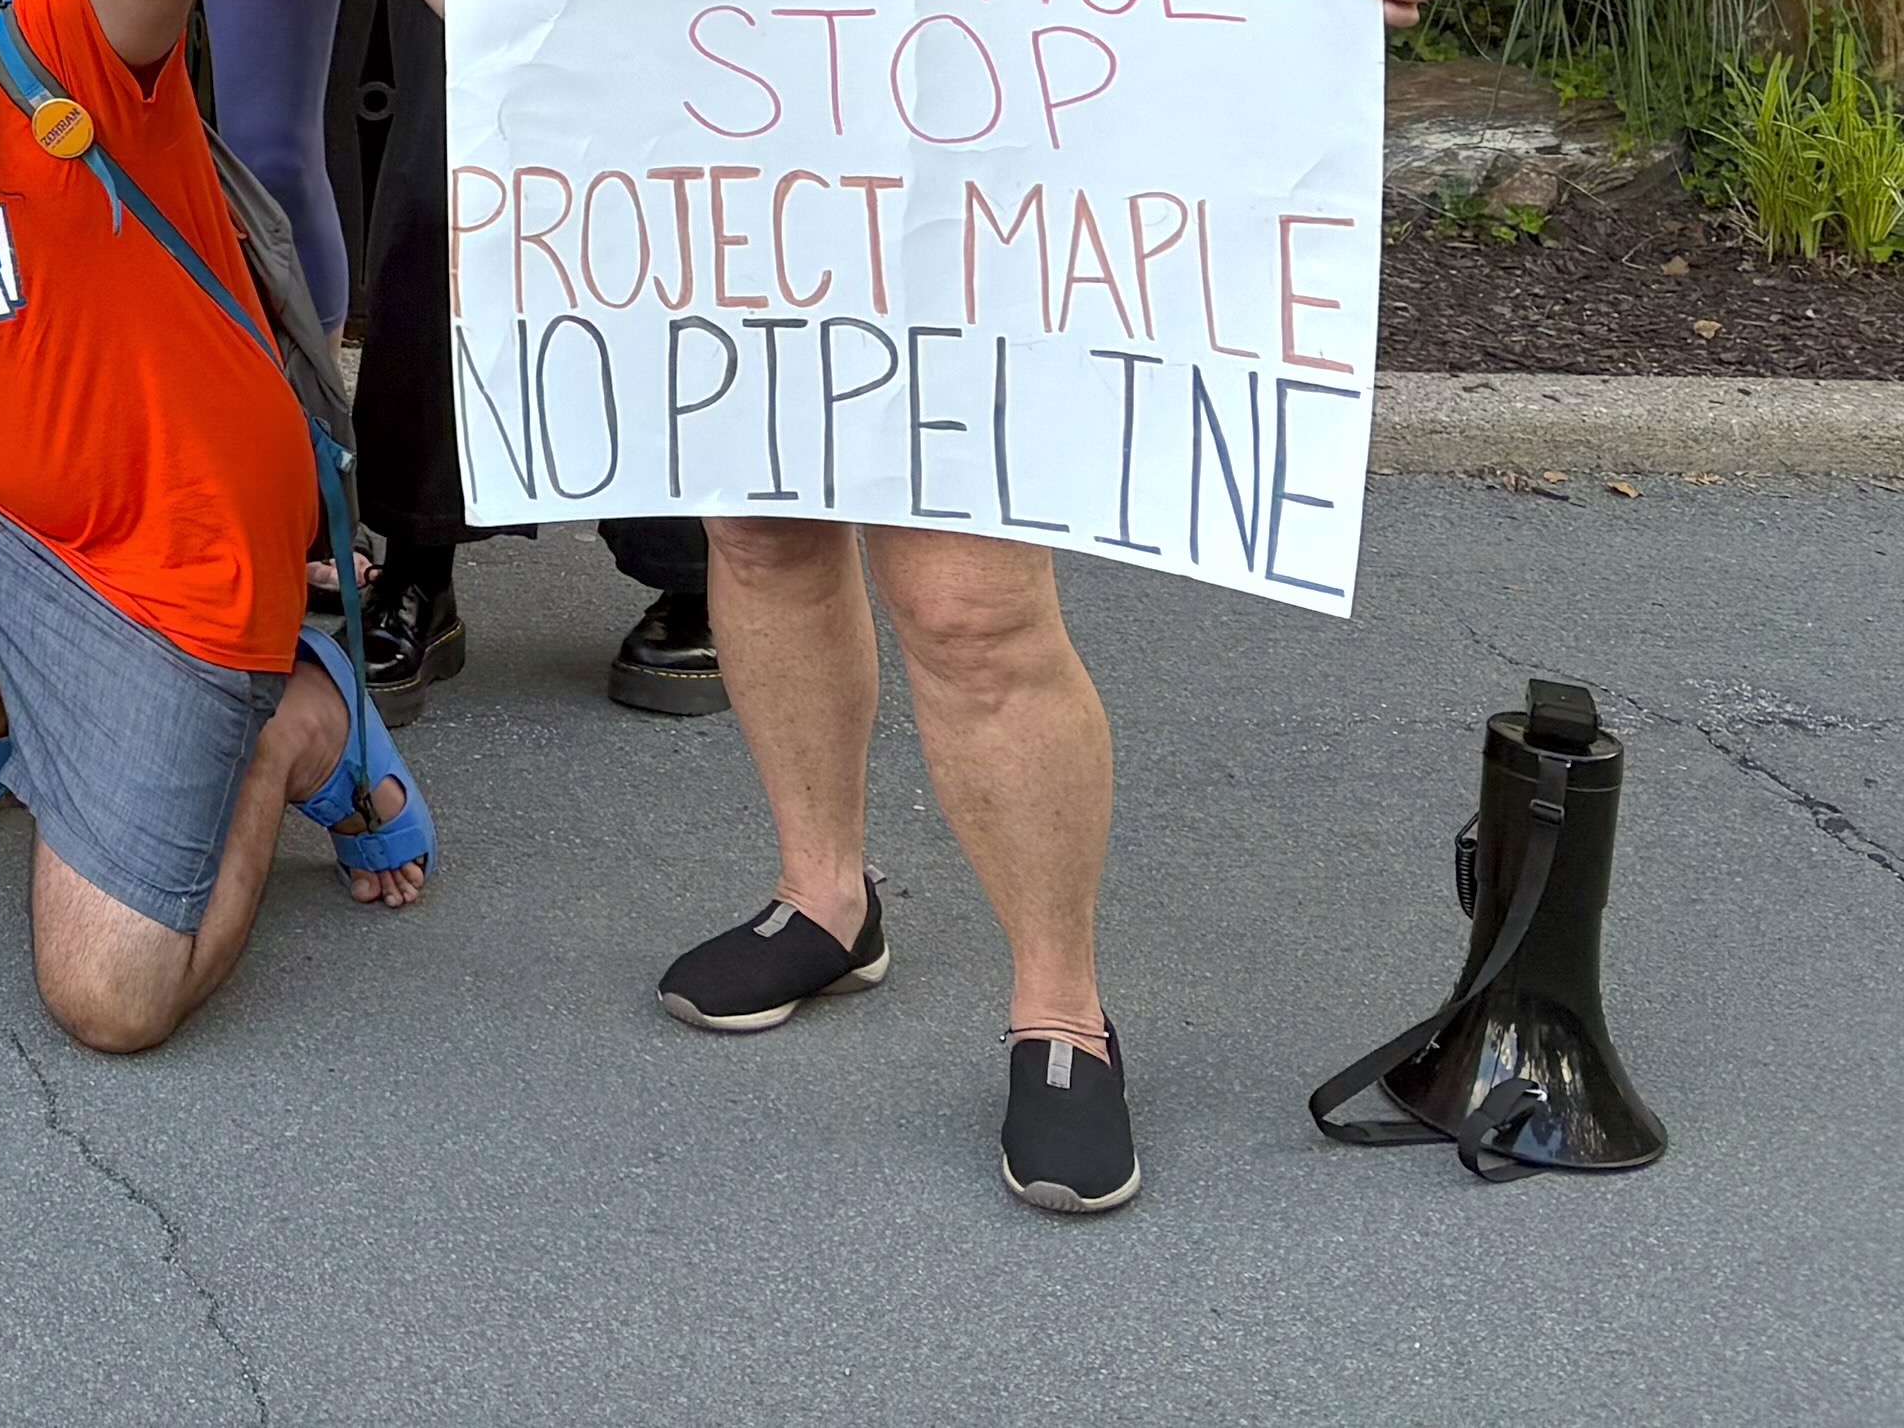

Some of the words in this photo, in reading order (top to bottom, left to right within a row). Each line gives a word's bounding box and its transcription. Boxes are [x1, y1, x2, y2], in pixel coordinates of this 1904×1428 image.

[684, 5, 1118, 150] STOP
[451, 165, 905, 318] PROJECT
[962, 181, 1355, 375] MAPLE
[454, 312, 619, 504] NO
[667, 314, 1361, 598] PIPELINE
